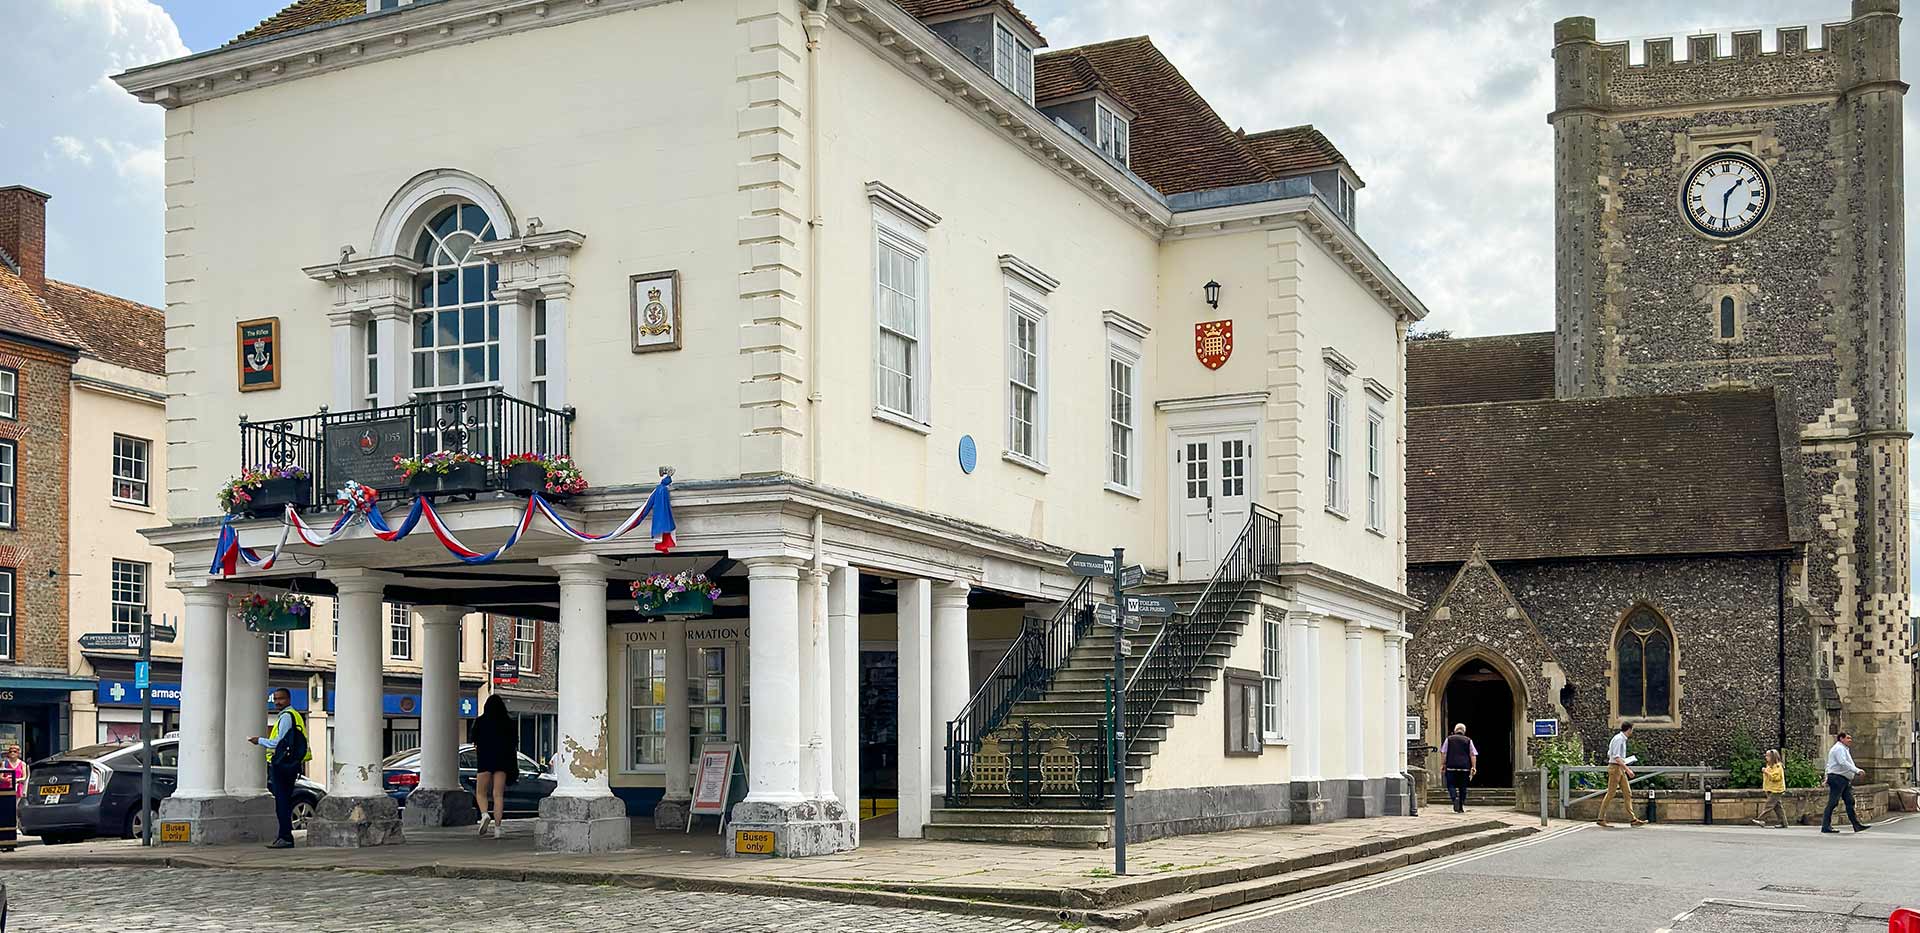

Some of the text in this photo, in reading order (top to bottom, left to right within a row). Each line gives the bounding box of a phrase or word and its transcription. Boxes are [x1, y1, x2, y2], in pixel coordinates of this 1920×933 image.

[625, 631, 658, 642] TOWN
[165, 824, 185, 832] Buses
[168, 832, 183, 840] only
[743, 832, 768, 841] Buses
[746, 842, 764, 851] only
